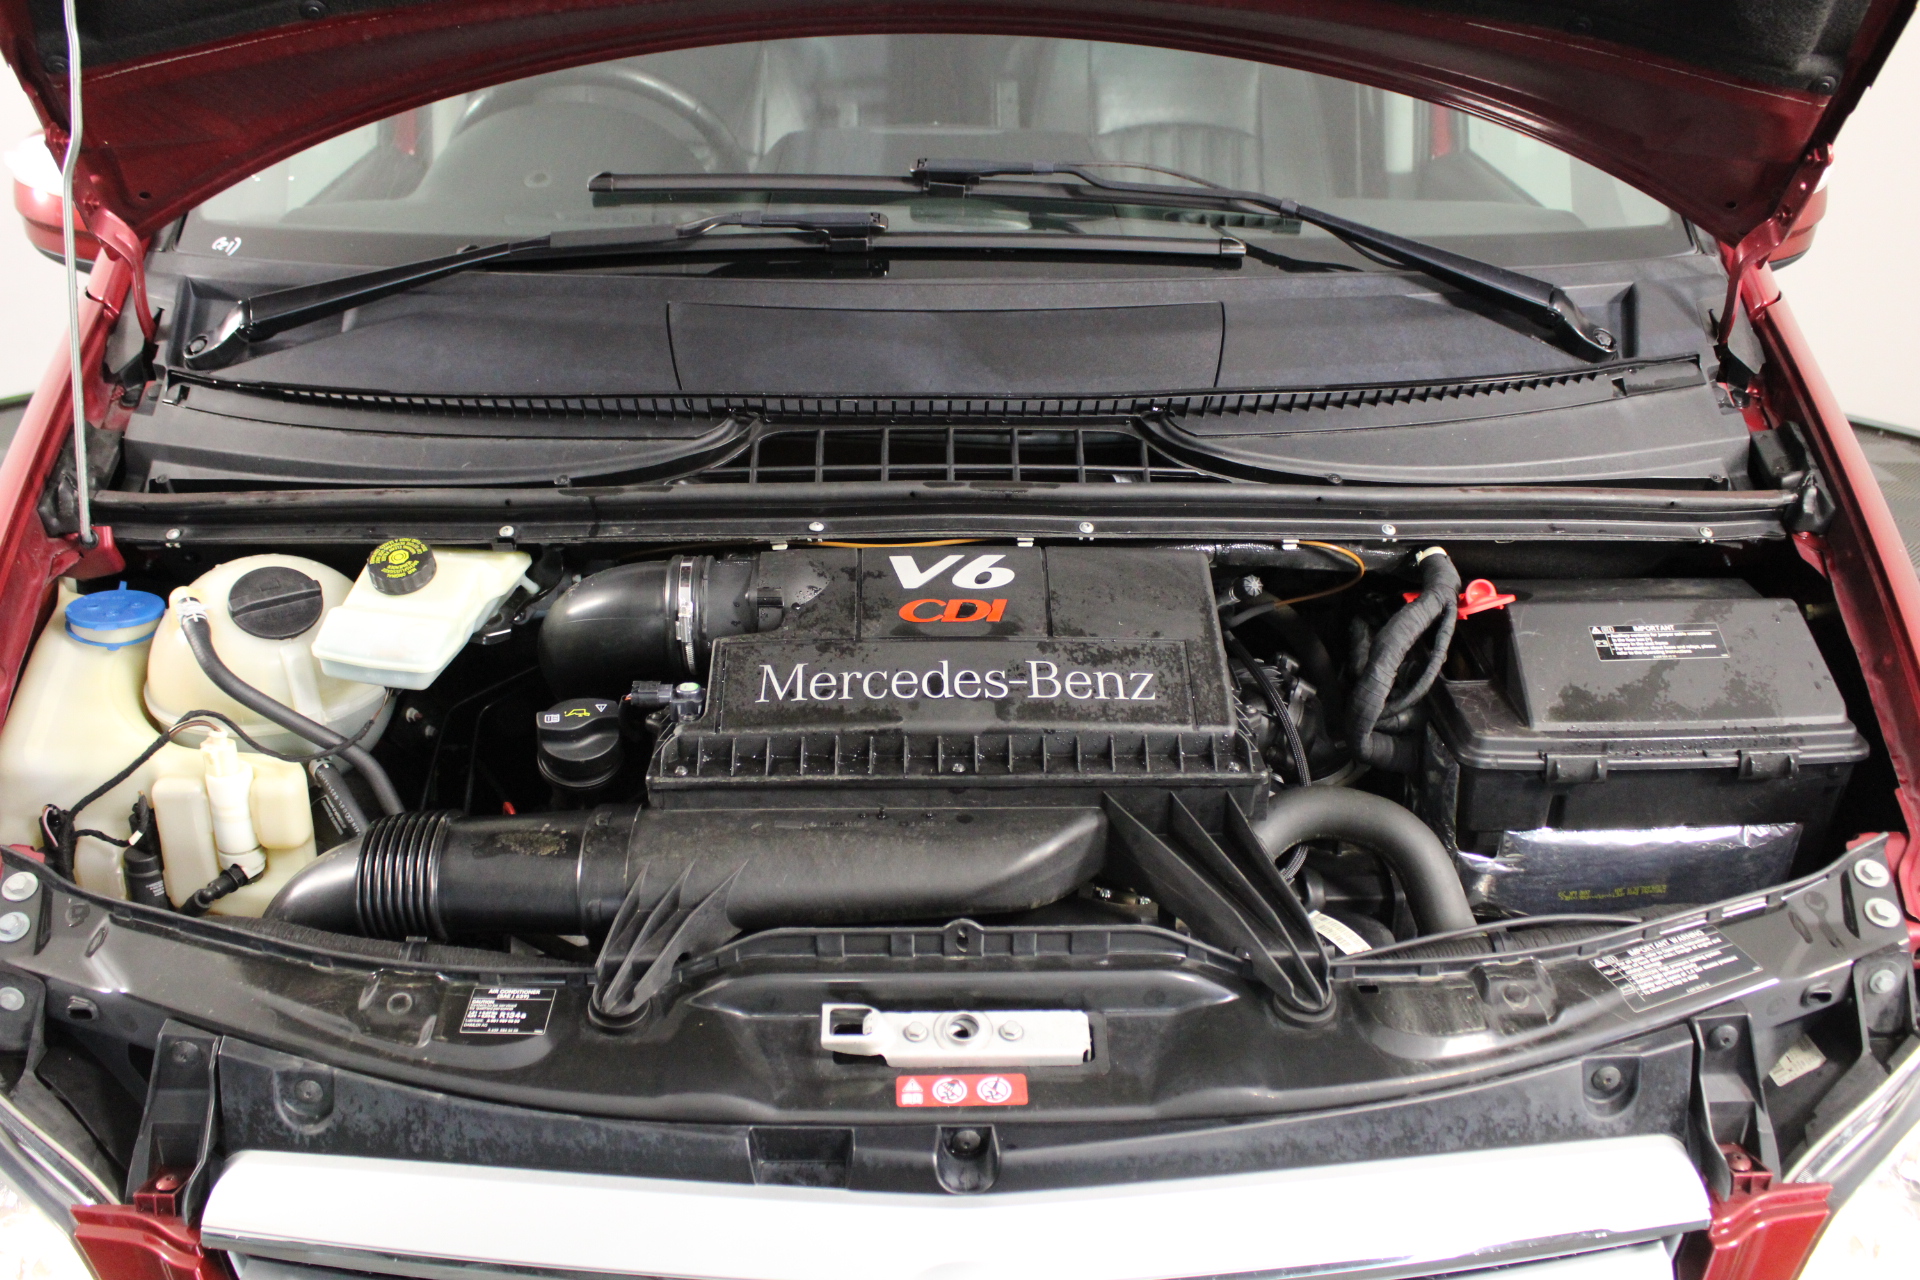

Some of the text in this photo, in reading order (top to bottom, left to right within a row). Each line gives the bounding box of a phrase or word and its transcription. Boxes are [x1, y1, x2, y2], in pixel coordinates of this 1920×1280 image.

[888, 555, 1015, 589] V6
[898, 598, 1008, 623] CDI
[755, 660, 1156, 703] Mercedes-Benz
[1626, 938, 1671, 957] IMPORTANT
[1668, 929, 1705, 944] WARNING
